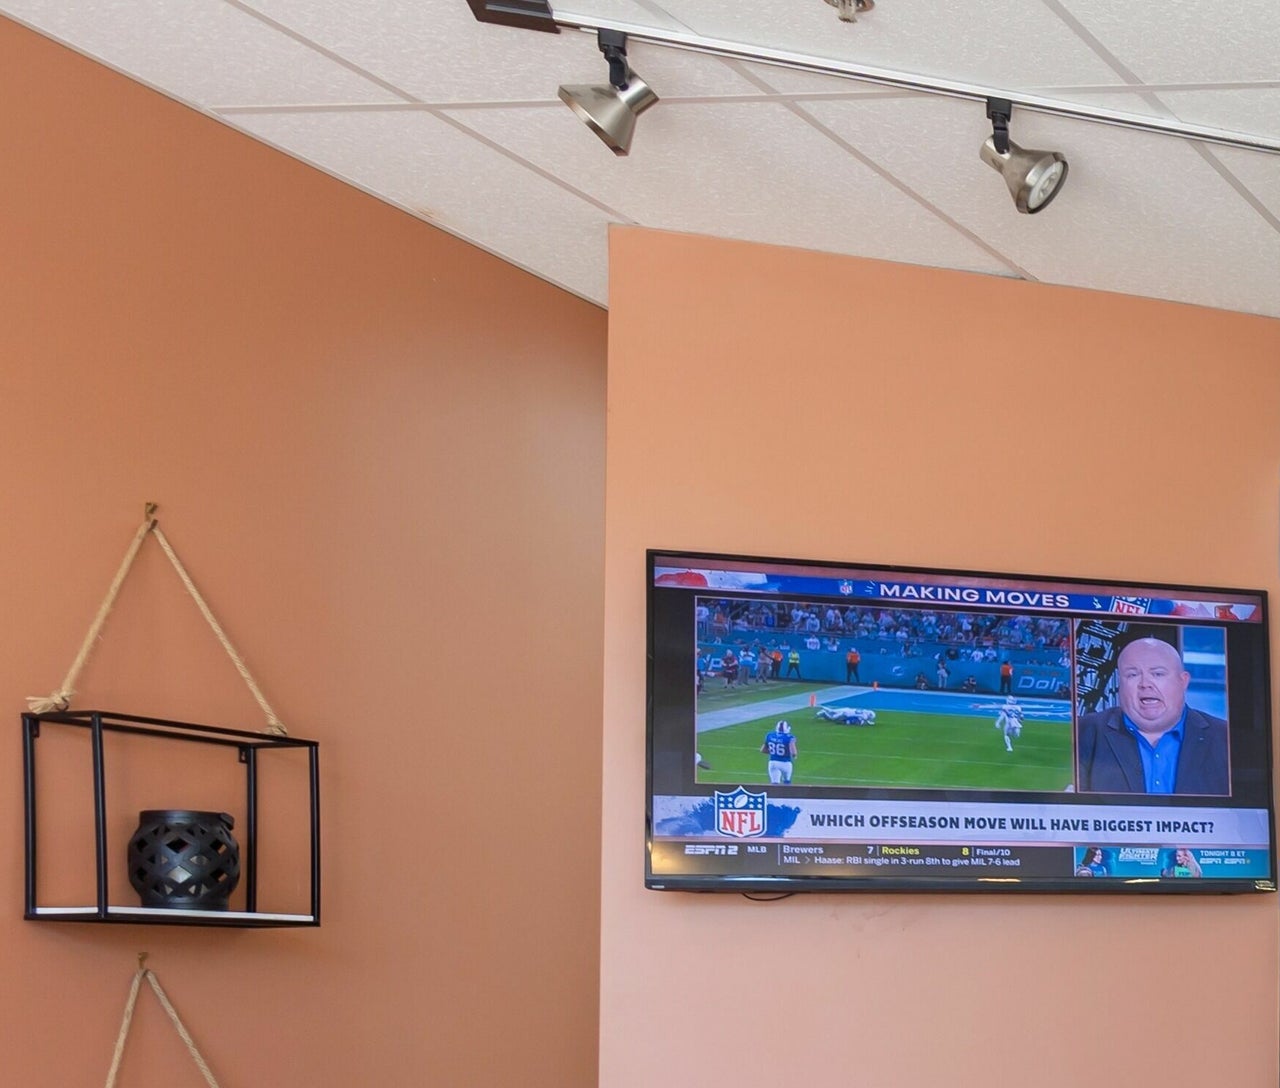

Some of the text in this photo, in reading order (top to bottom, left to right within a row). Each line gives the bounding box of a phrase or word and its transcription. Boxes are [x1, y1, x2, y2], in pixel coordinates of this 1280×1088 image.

[880, 583, 1070, 607] MAKING MOVES
[767, 741, 785, 756] 86
[721, 810, 761, 835] NFL
[809, 813, 1214, 834] WHICH OFFSEASON MOVE WILL HAVE BIGGEST IMPACT?
[783, 845, 873, 854] Brewers 7
[882, 846, 969, 856] Rockies 8
[976, 848, 1011, 856] Final/10
[783, 856, 800, 864] MIL
[814, 856, 845, 865] Haase:
[863, 856, 889, 866] single
[901, 857, 924, 865] 3-run
[925, 857, 940, 865] 8th
[952, 857, 969, 867] give
[971, 858, 987, 866] MIL
[988, 858, 1001, 866] 7-6
[1003, 858, 1020, 866] lead
